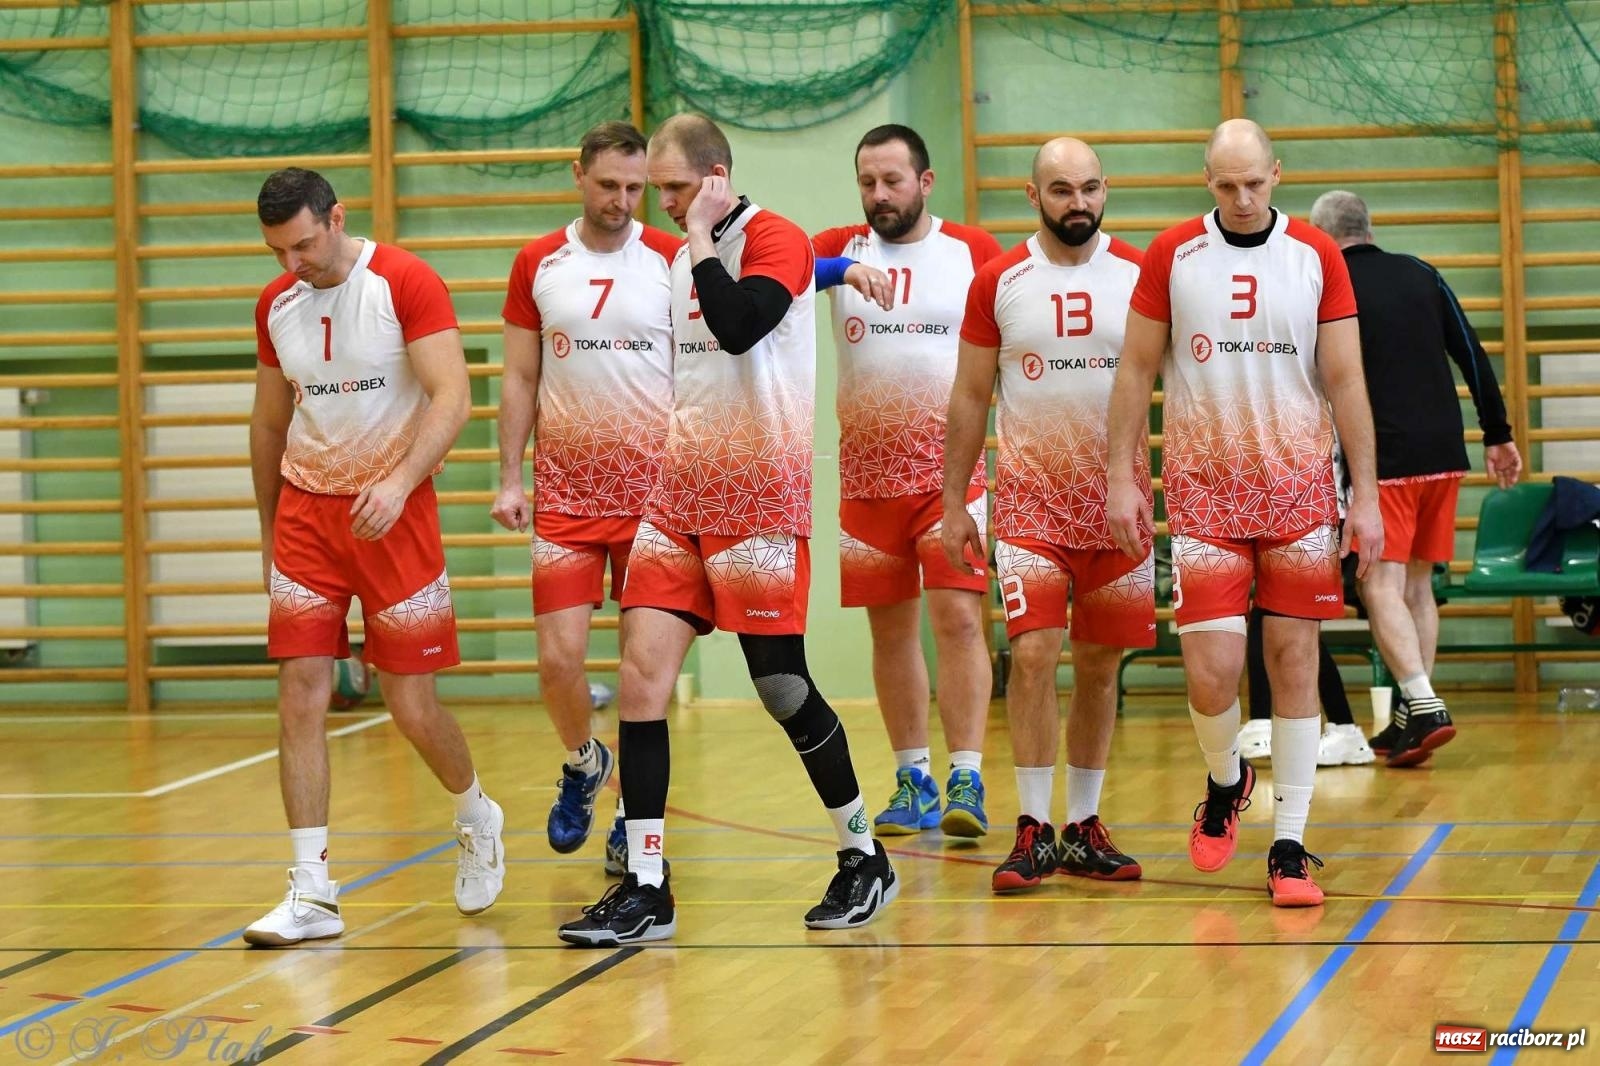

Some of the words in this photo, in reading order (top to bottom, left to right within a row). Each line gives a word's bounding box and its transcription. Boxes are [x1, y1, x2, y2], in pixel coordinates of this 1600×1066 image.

[1176, 241, 1209, 261] DAMONS
[1003, 263, 1034, 286] DAMONS
[887, 267, 912, 305] 11
[589, 278, 614, 320] 7
[1230, 274, 1258, 320] 3
[1050, 291, 1093, 338] 13
[320, 316, 332, 362] 1
[869, 323, 905, 334] TOKAI
[906, 323, 949, 335] COBEX
[574, 339, 612, 351] TOKAI
[613, 339, 653, 351] COBEX
[679, 342, 706, 354] TOKAI
[1217, 341, 1254, 353] TOKAI
[1256, 342, 1298, 356] COBEX
[1048, 358, 1086, 371] TOKAI
[1088, 357, 1120, 369] COBE
[305, 382, 340, 397] TOKAI
[342, 376, 386, 393] COBEX
[746, 609, 780, 618] DAMONS
[644, 834, 661, 850] R
